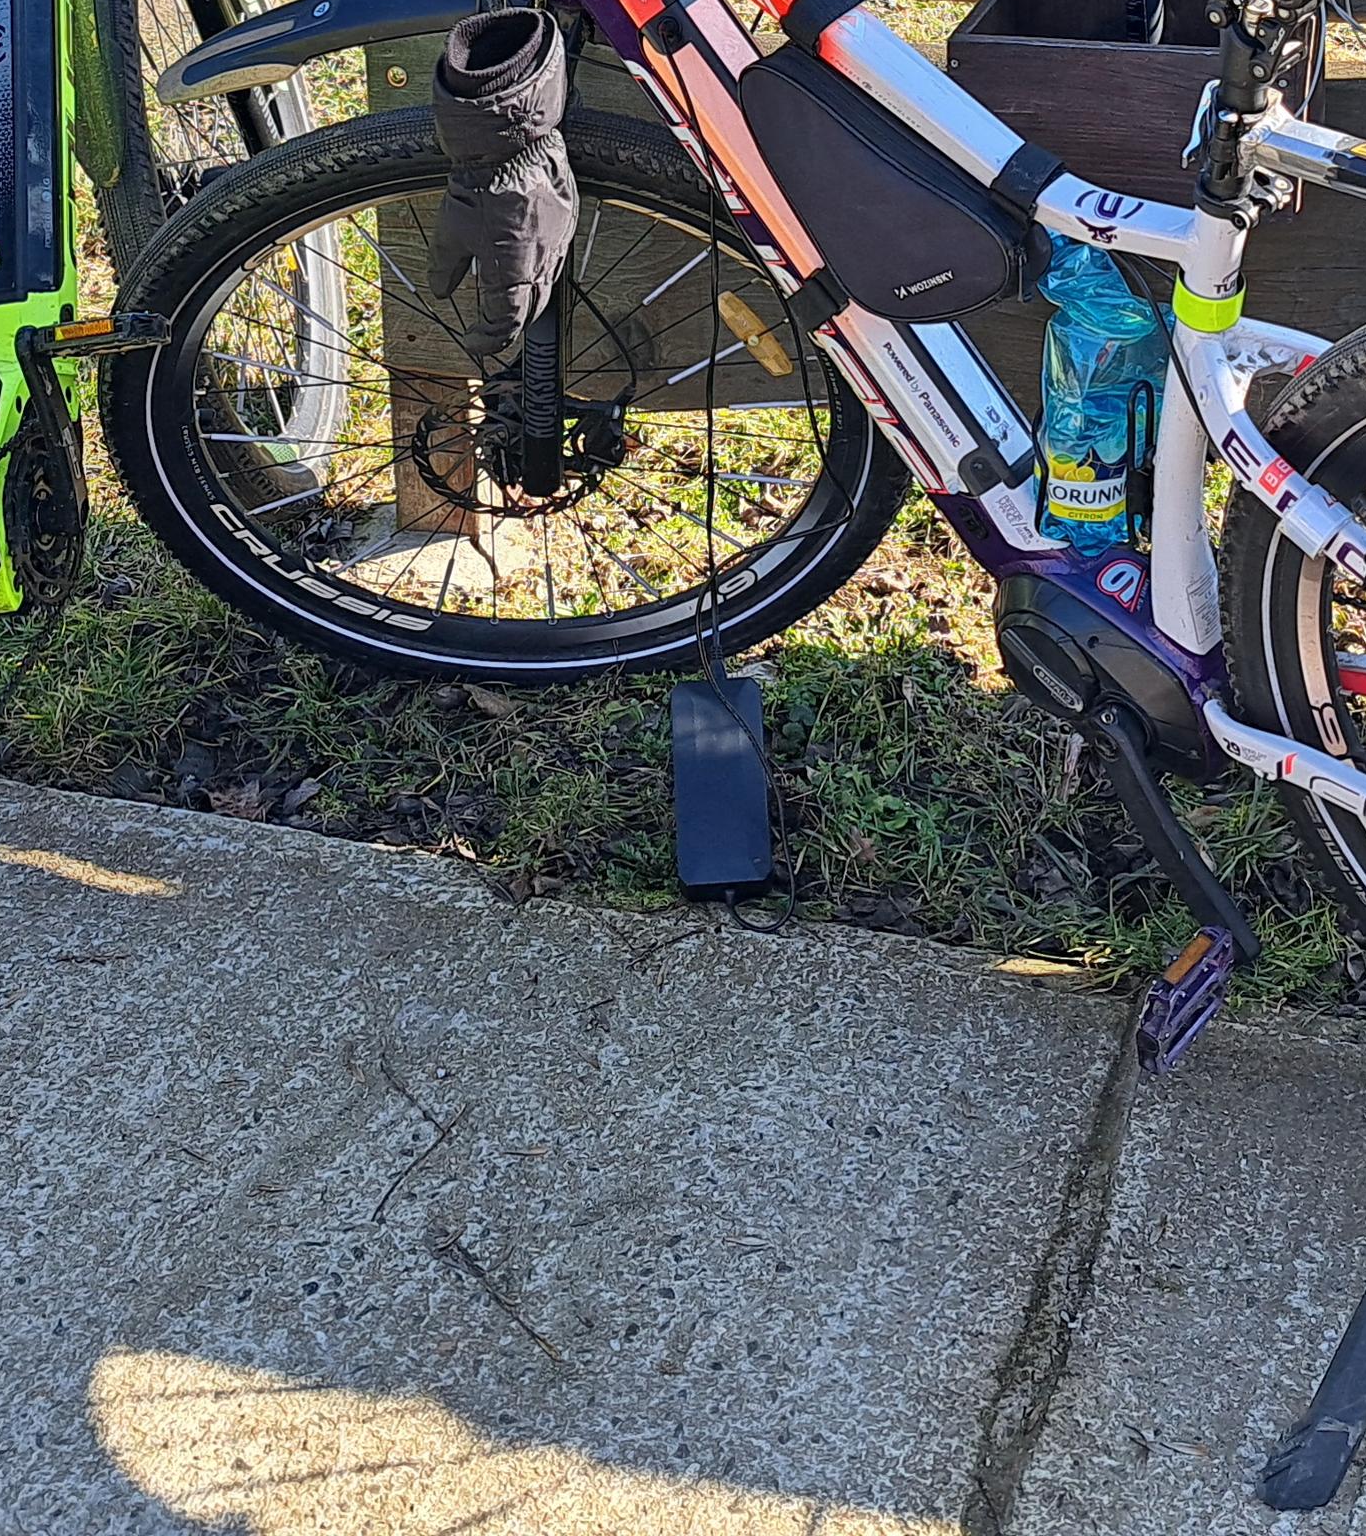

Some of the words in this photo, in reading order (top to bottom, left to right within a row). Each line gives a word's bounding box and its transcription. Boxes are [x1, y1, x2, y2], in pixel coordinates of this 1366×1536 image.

[906, 270, 955, 295] WOZINSKY
[917, 390, 962, 449] Panasonic
[1047, 482, 1130, 506] KORUNN
[209, 503, 434, 632] CRUSSIS
